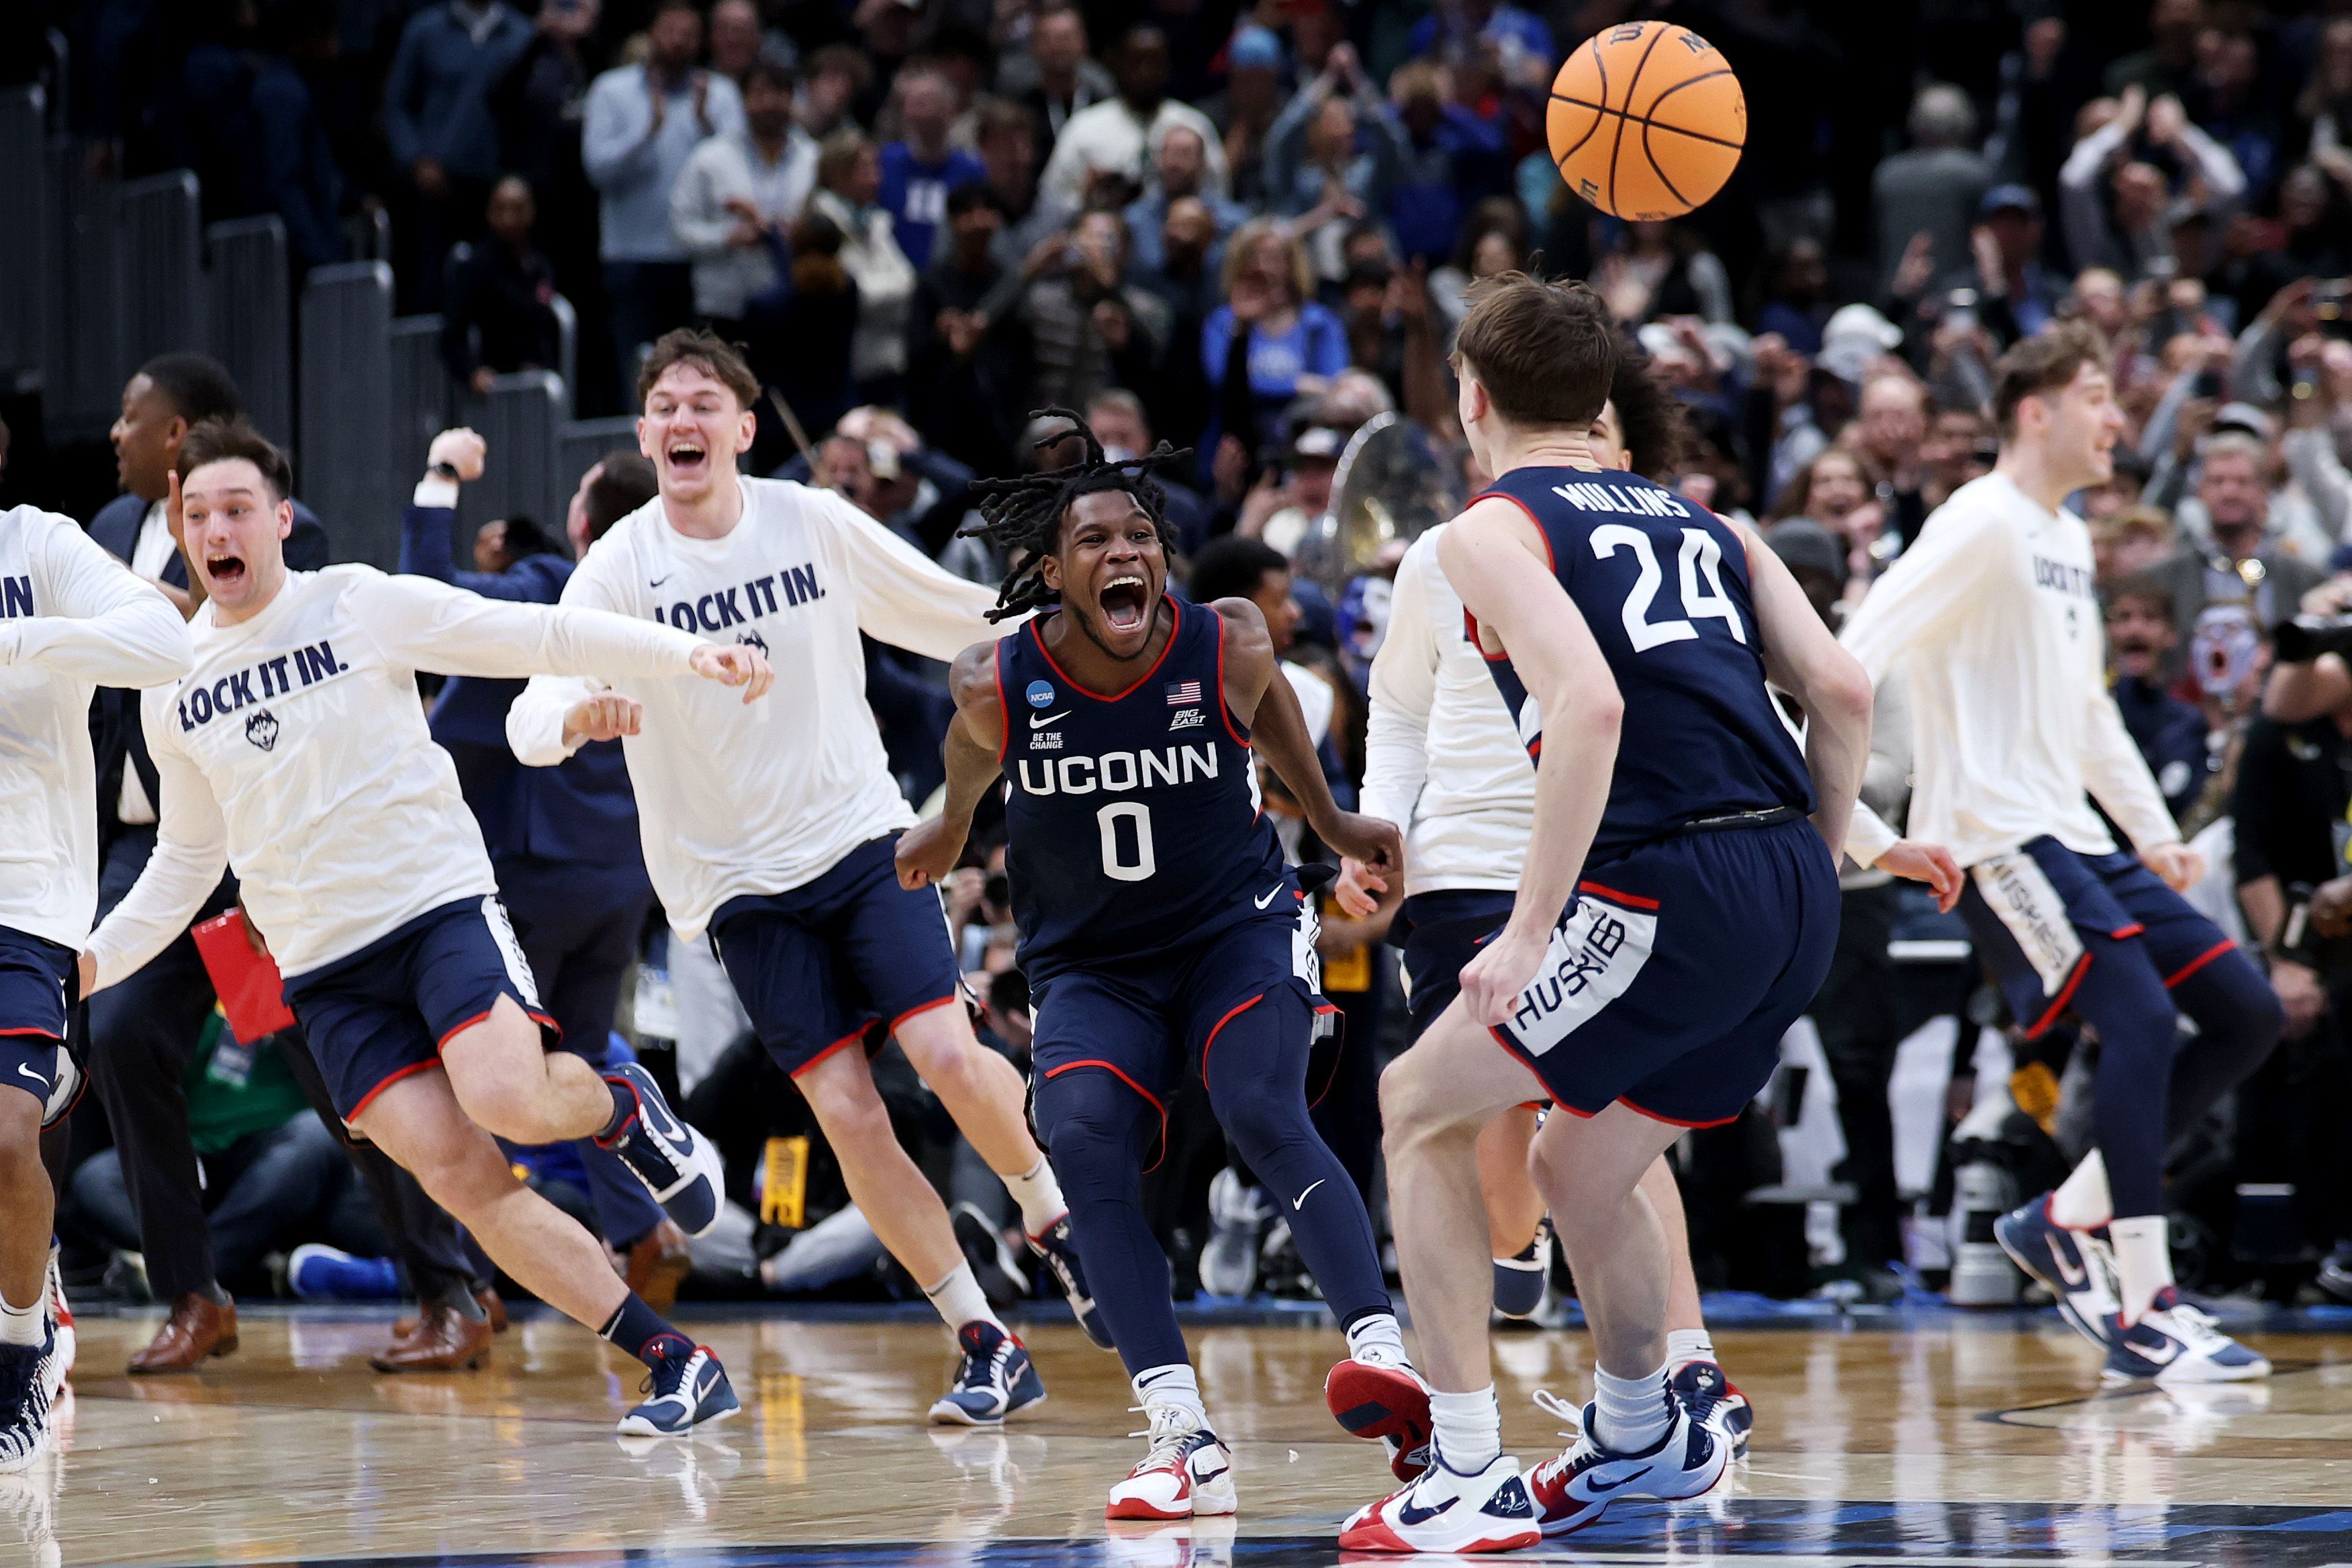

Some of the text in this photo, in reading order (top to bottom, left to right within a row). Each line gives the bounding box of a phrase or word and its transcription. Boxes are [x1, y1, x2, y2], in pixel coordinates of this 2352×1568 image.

[1551, 482, 1691, 518] MULLINS
[745, 574, 779, 620] IT
[780, 561, 826, 607] IN.
[1589, 524, 1747, 654] 24
[258, 654, 291, 699] IT
[293, 638, 349, 686] IN.
[1031, 691, 1053, 703] NCAA
[1173, 708, 1200, 720] BIG
[1032, 732, 1062, 742] BE THE
[1170, 715, 1207, 727] EAST
[1029, 740, 1064, 750] CHANGE
[1018, 740, 1219, 796] UCONN
[1096, 801, 1156, 882] 0
